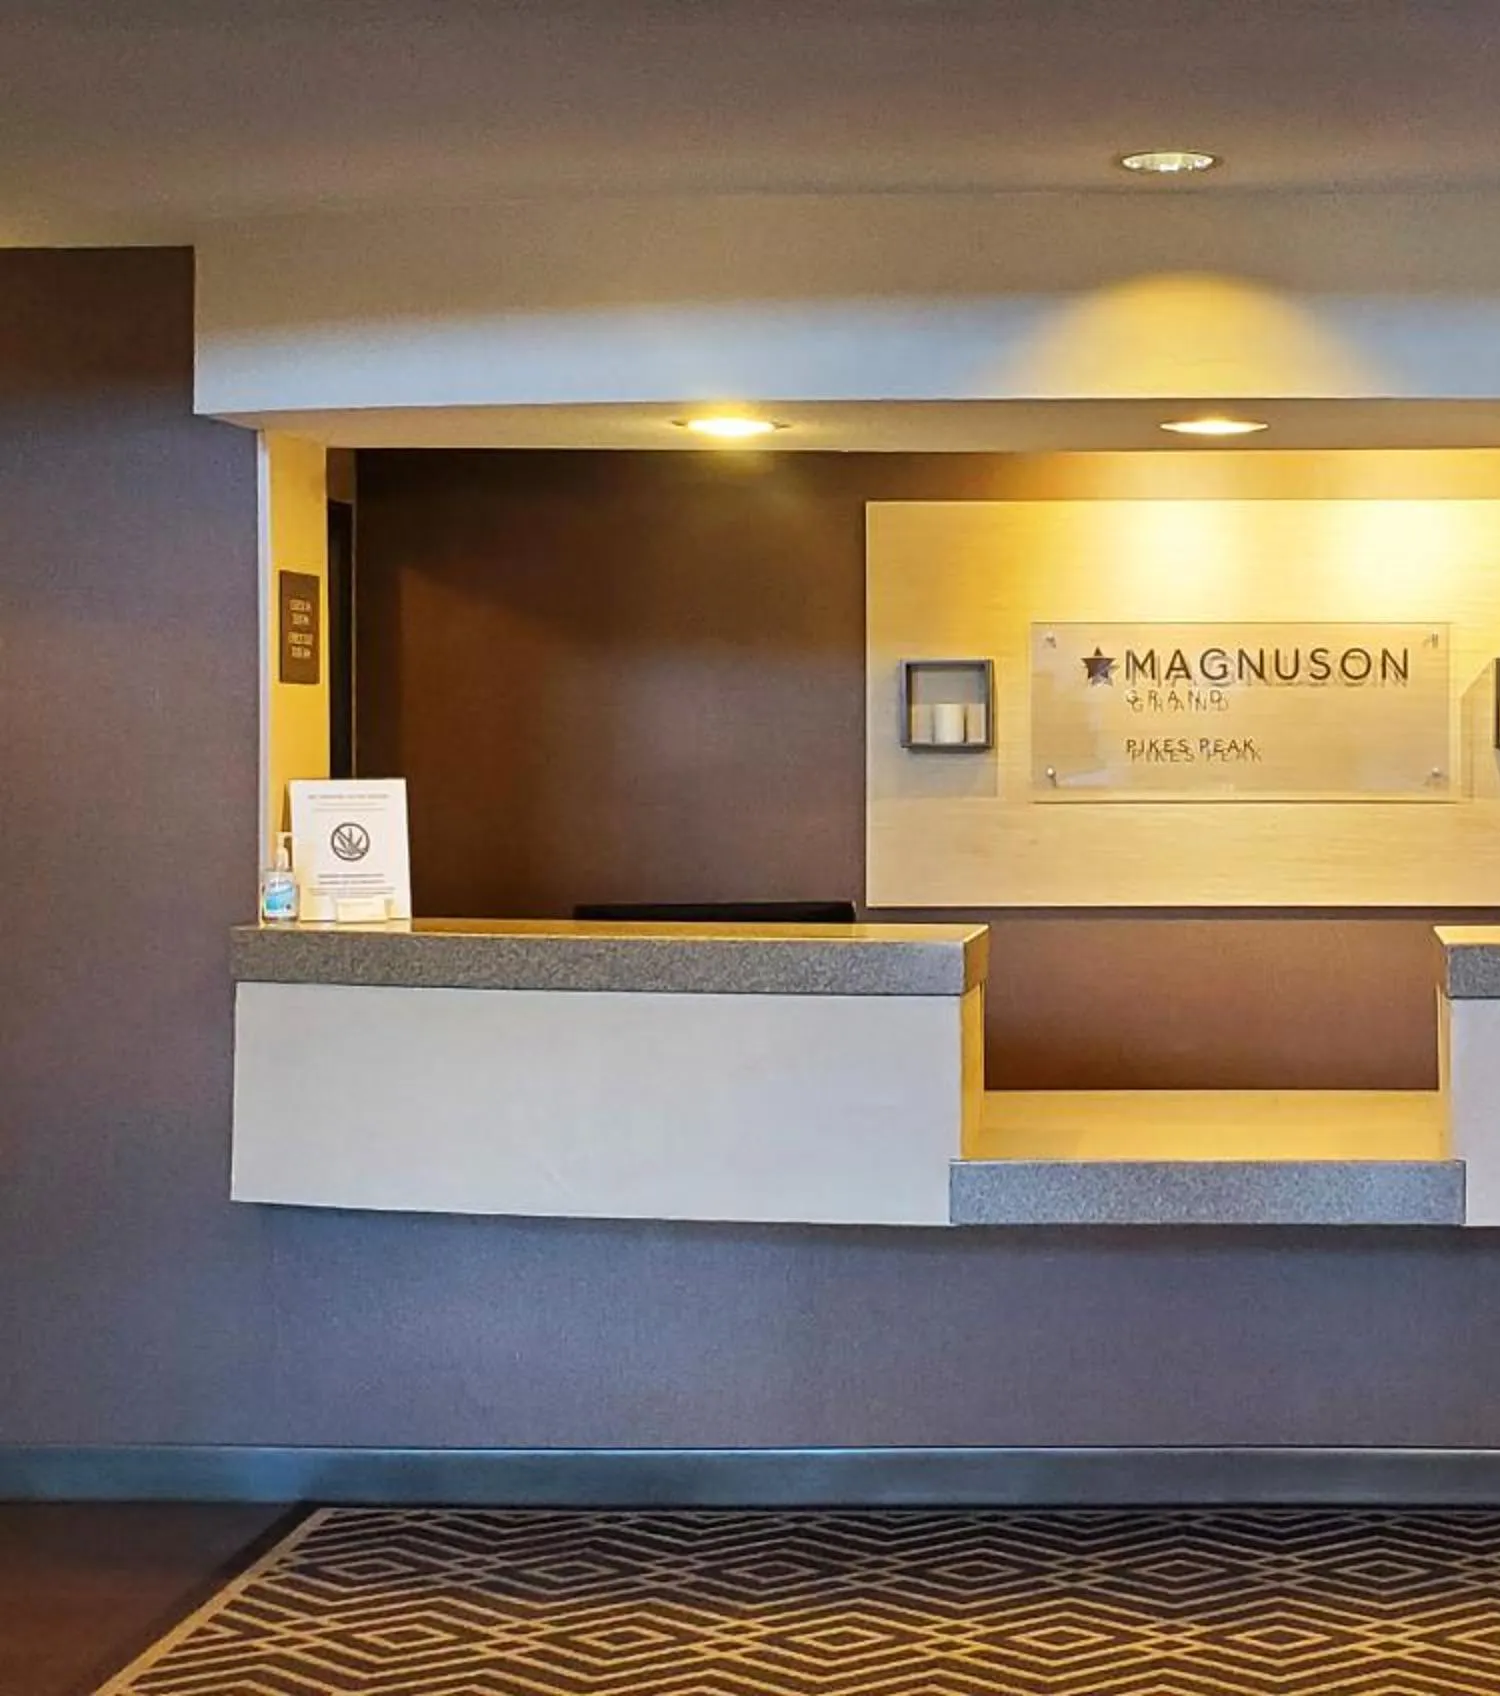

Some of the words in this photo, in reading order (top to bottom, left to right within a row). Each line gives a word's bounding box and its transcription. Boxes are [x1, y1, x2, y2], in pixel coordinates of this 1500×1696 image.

[1125, 647, 1409, 681] MAGNUSON
[1125, 689, 1223, 705] GRAND
[1126, 738, 1189, 753] PIKES
[1199, 737, 1255, 753] PEAK
